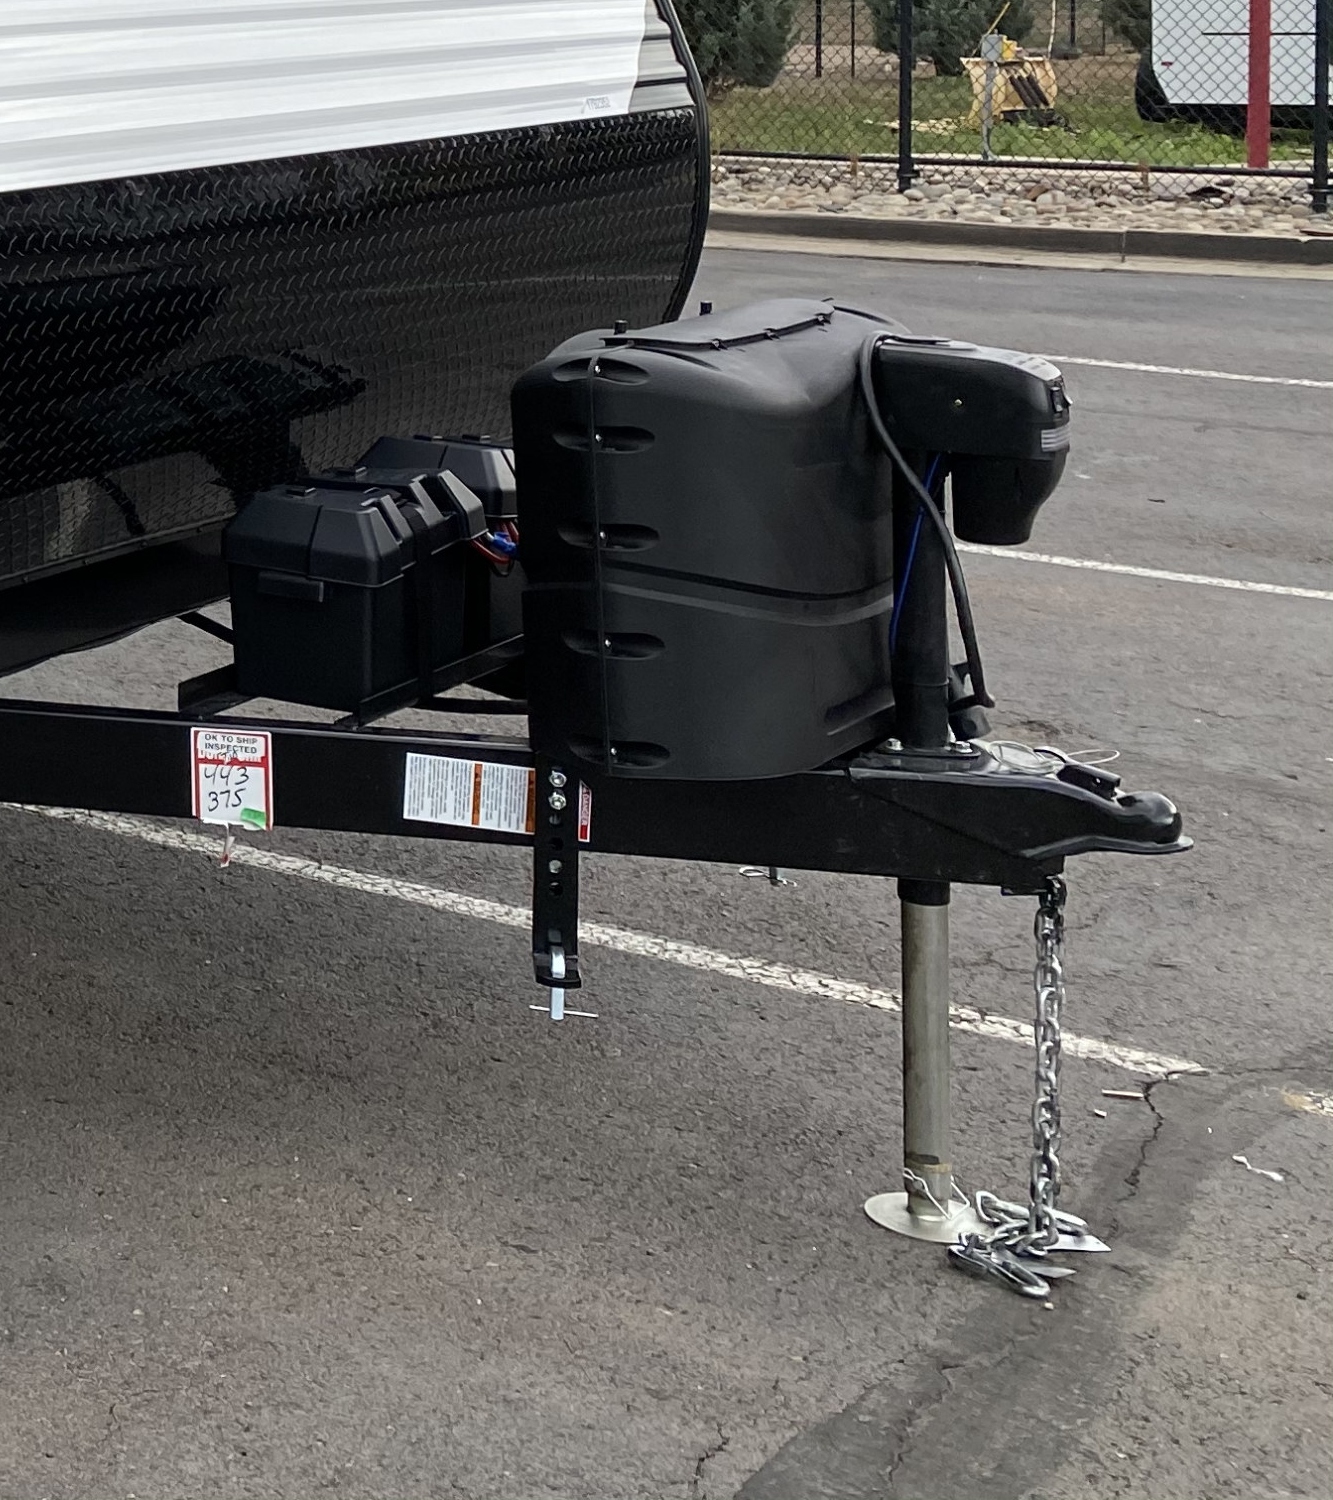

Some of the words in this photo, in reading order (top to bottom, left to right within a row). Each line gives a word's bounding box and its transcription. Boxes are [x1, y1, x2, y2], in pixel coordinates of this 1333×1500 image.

[204, 742, 258, 754] INSPECTED
[205, 734, 218, 742] OK
[221, 735, 234, 743] TO
[236, 736, 258, 745] SHIP
[204, 764, 249, 786] 443
[208, 787, 247, 812] 375
